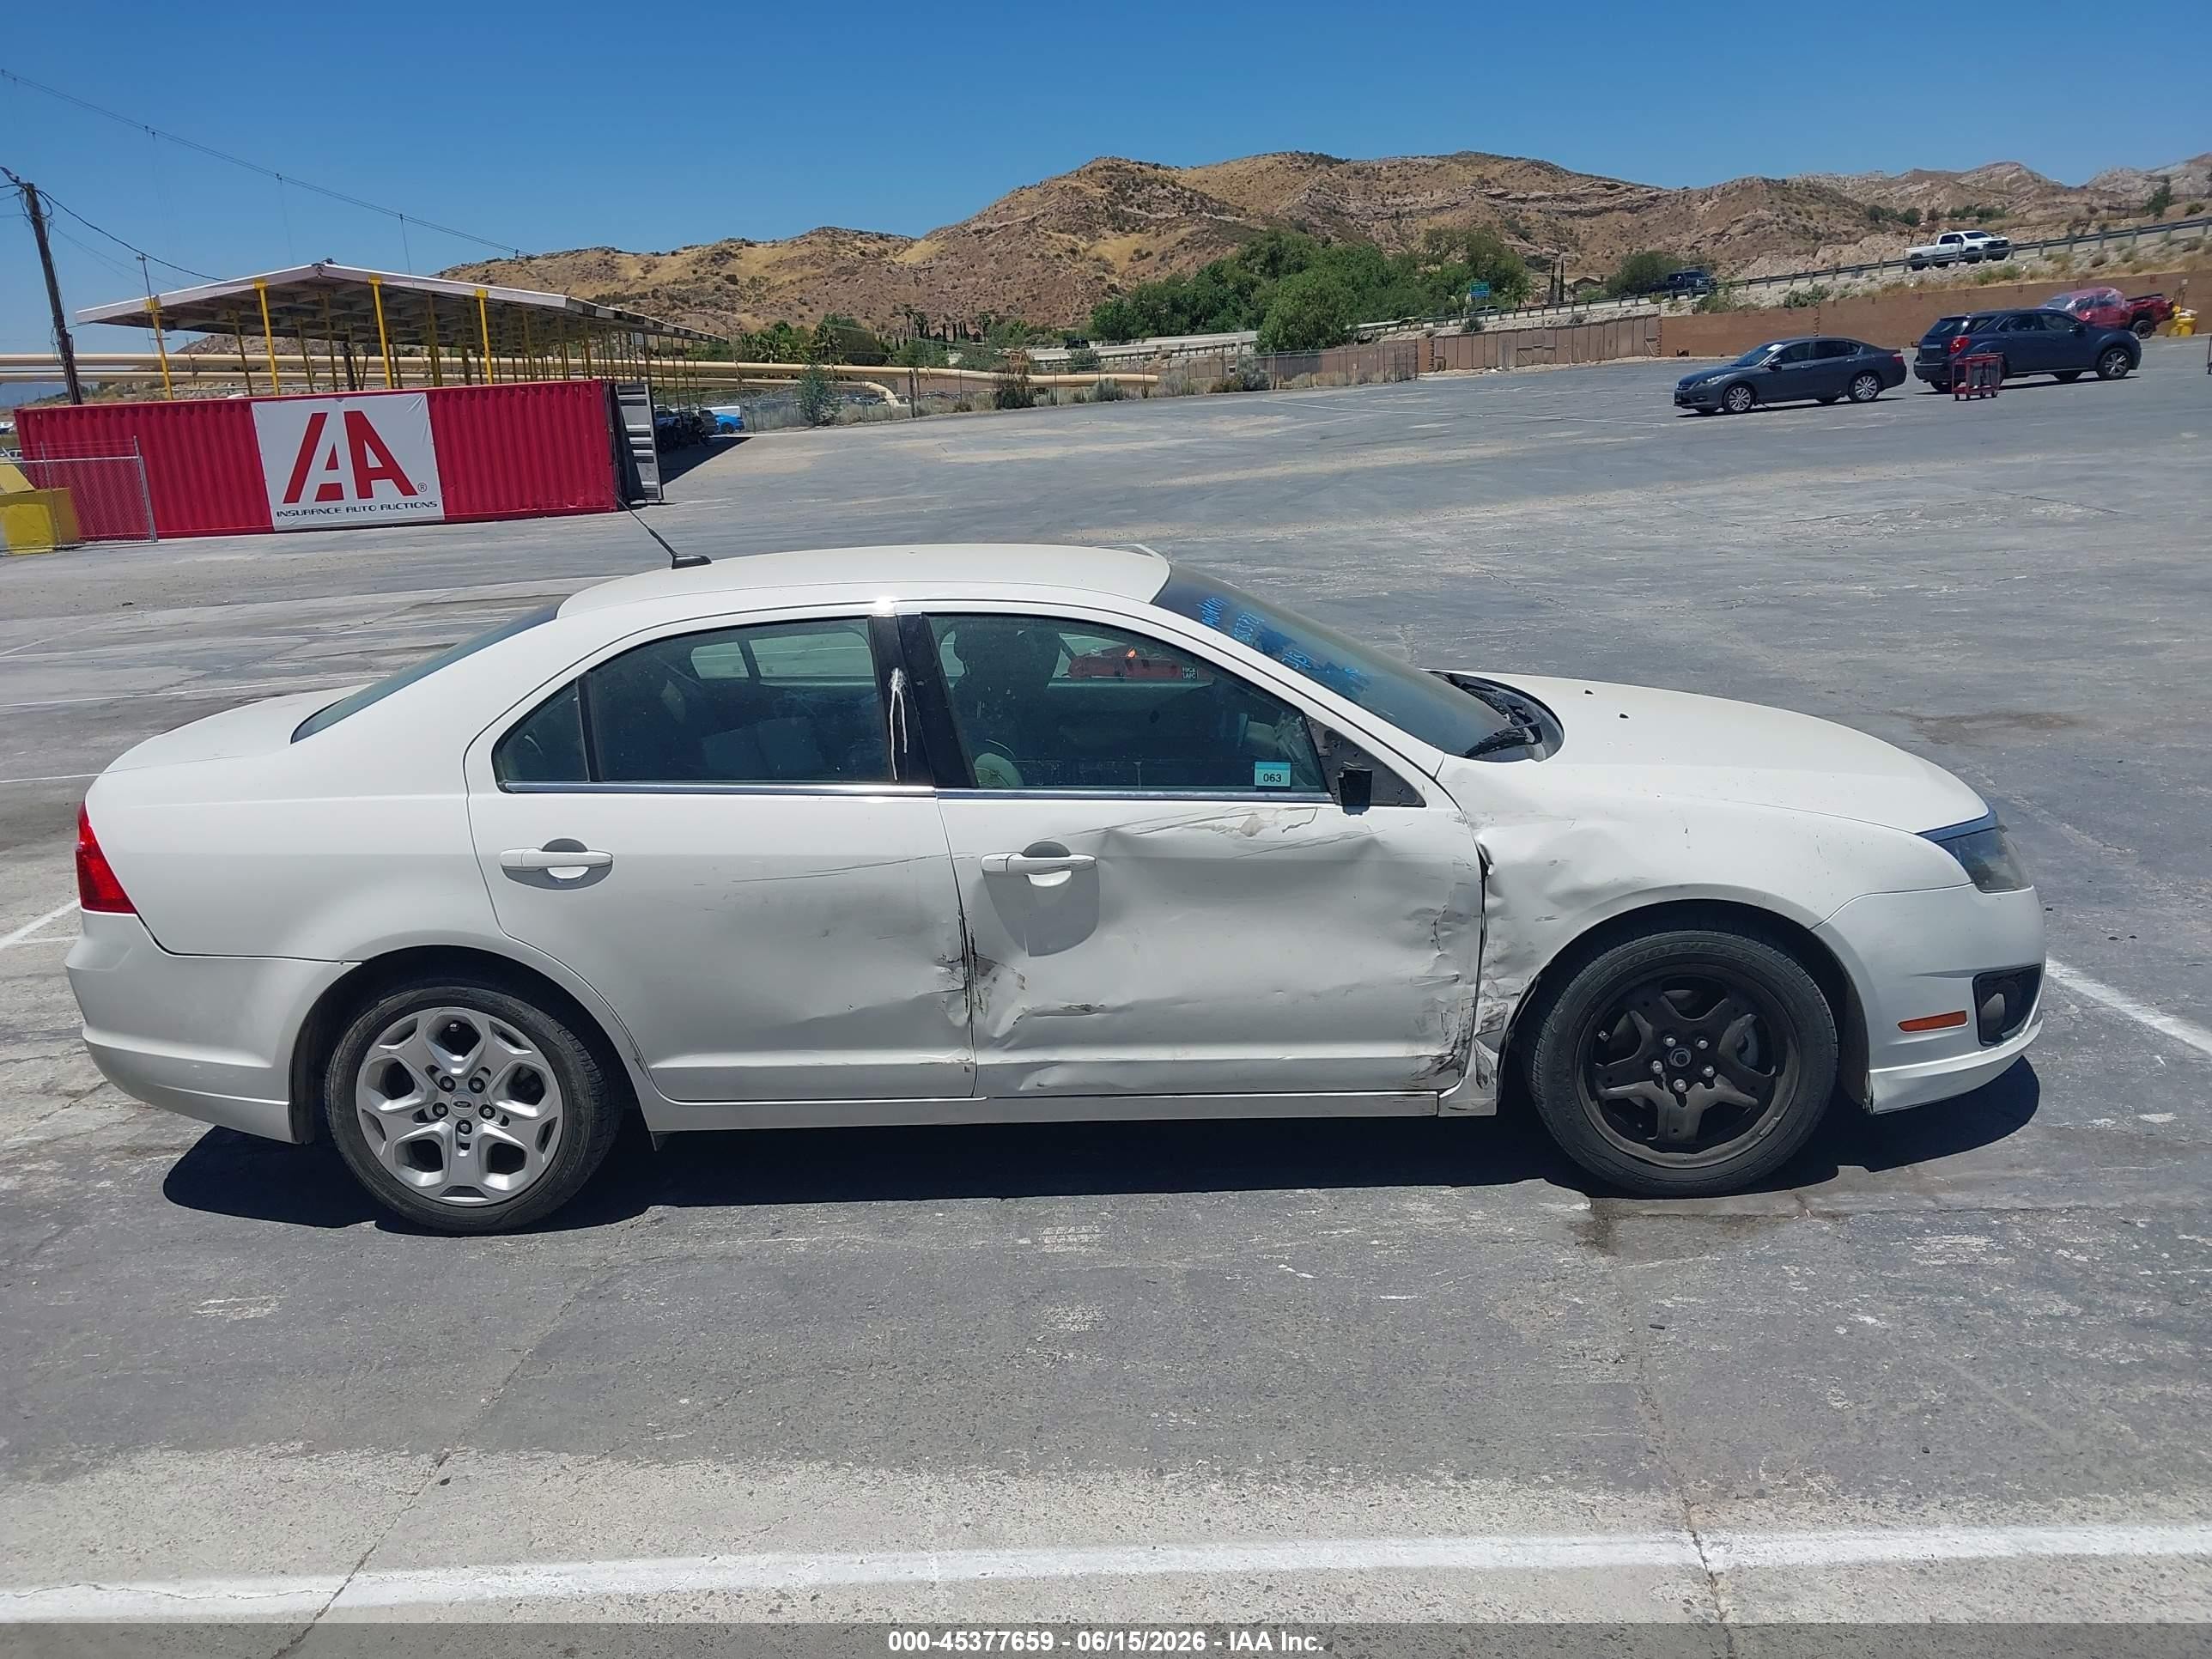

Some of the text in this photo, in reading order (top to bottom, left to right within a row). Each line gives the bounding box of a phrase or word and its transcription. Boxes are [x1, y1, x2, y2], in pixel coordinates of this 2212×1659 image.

[276, 501, 439, 518] INSURANCE AUTO AUCTIONS
[1263, 773, 1282, 782] 063
